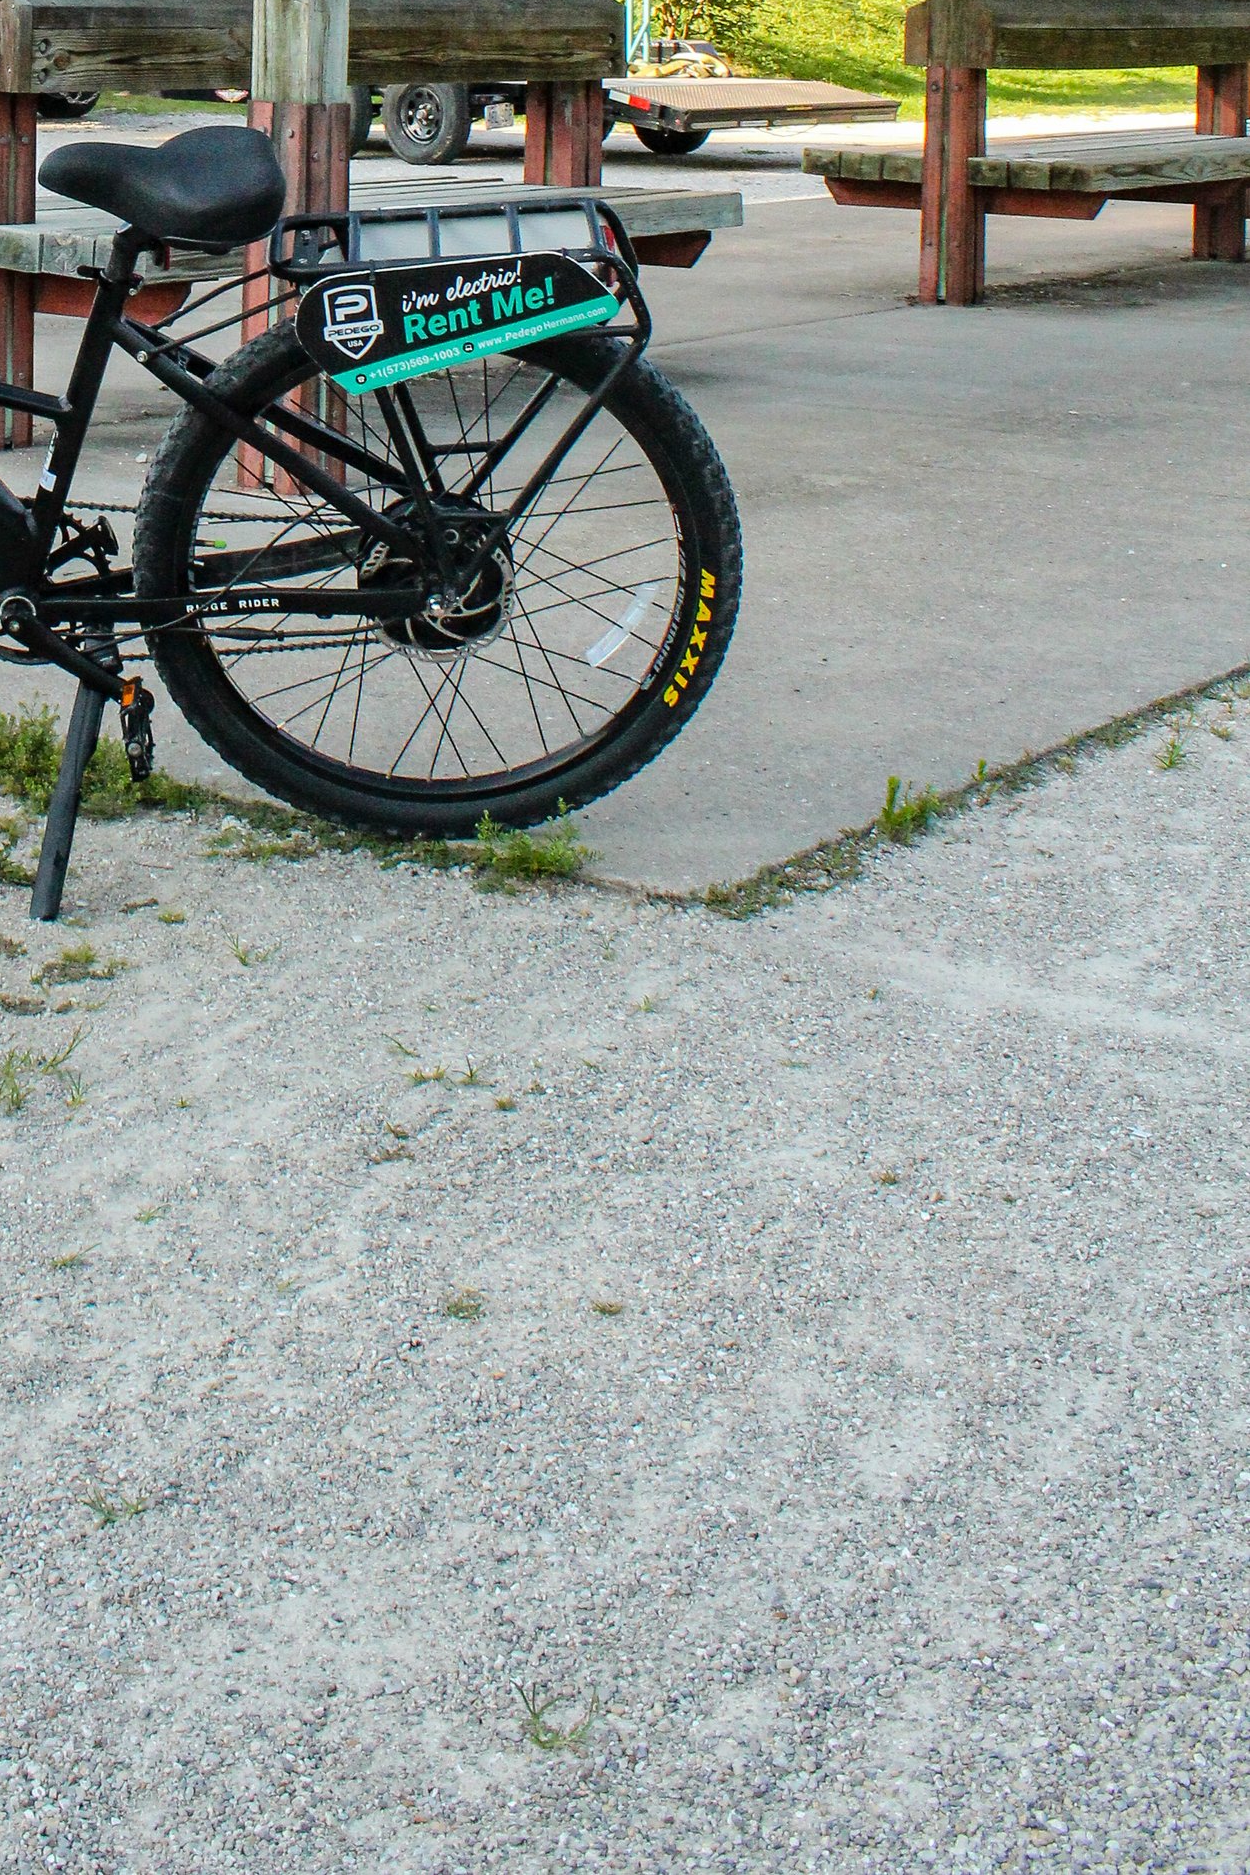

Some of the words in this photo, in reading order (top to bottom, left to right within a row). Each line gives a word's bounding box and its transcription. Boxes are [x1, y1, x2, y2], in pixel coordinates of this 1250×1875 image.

[401, 289, 440, 313] i'm
[446, 260, 523, 301] electric!
[403, 299, 482, 344] Rent
[491, 277, 555, 321] Me!
[328, 324, 380, 338] PEDEGO
[347, 339, 364, 348] USA
[238, 598, 280, 609] RIDER
[663, 567, 716, 708] MAXXIS
